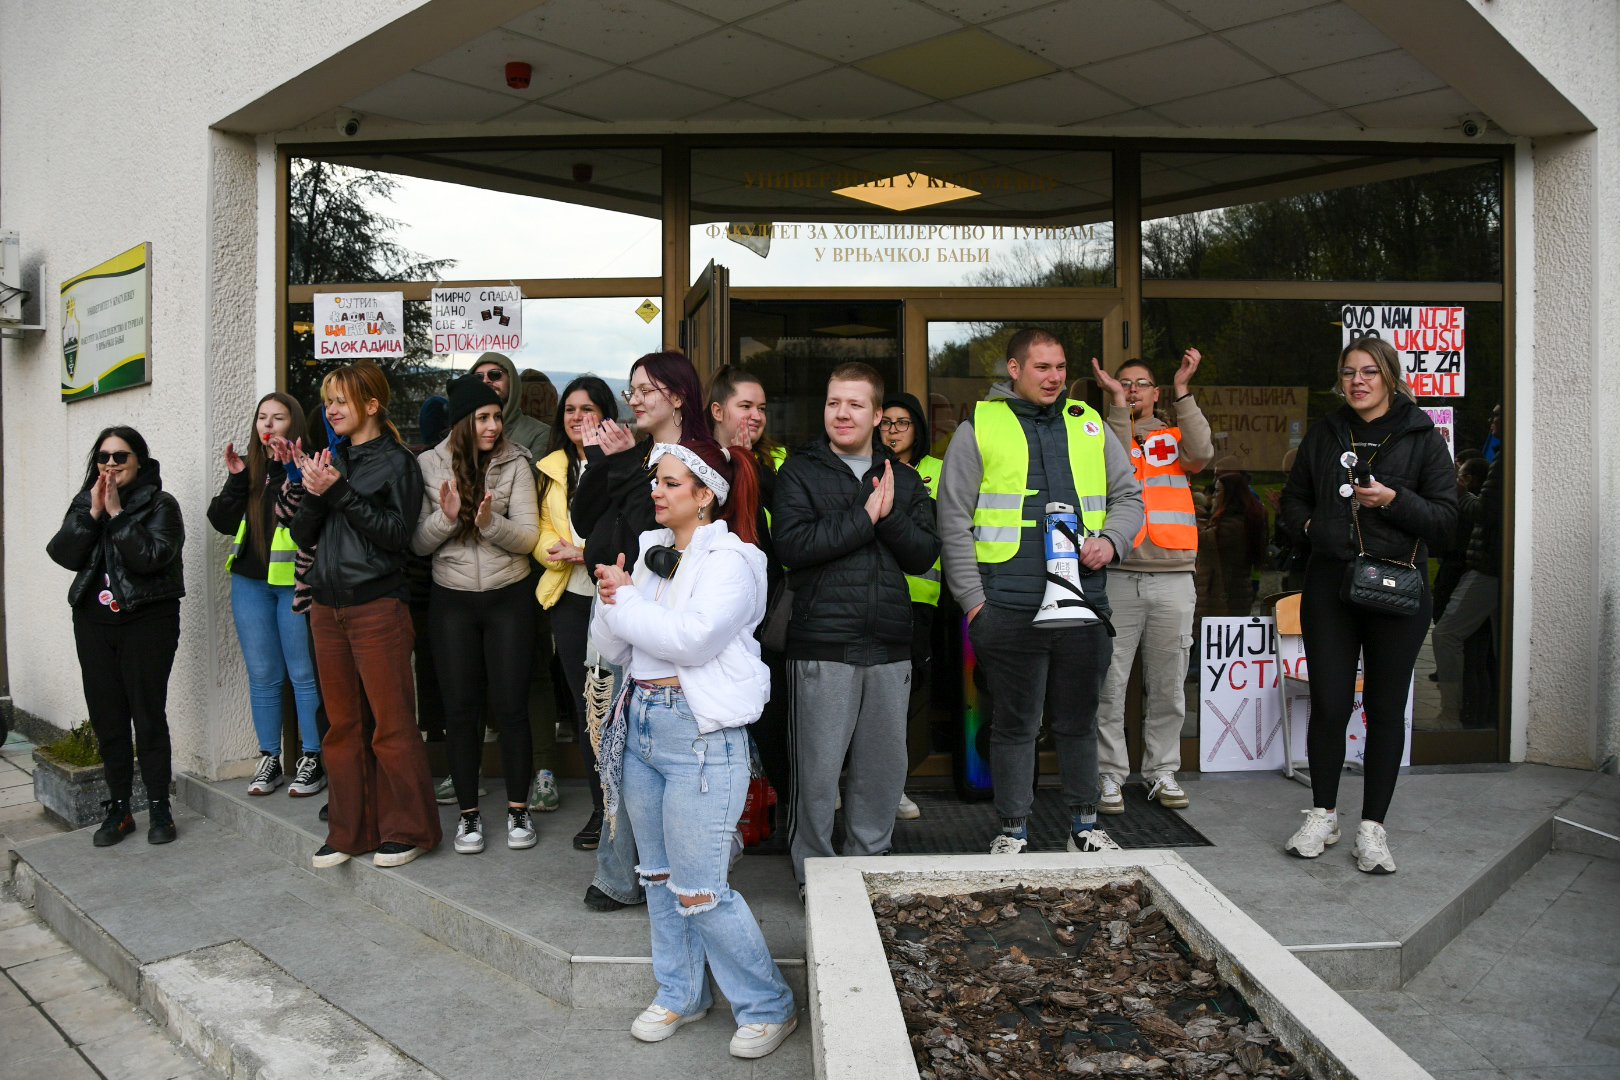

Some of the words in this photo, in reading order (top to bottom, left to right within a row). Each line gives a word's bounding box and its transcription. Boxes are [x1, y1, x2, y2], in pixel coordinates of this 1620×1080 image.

[743, 171, 896, 188] УНИВЕРЗИТЕТ
[906, 171, 919, 188] У
[927, 172, 1057, 190] КРАГУЈЕВЦУ
[705, 224, 802, 240] ФАКУЛТЕТ
[807, 224, 828, 240] ЗА
[833, 224, 986, 241] ХОТЕЛИЈЕРСТВО
[990, 225, 1005, 240] И
[1010, 225, 1095, 241] ТУРИЗАМ
[814, 247, 827, 263] У
[832, 247, 930, 263] ВРЊАЧКОЈ
[937, 247, 991, 263] БАЊИ
[435, 291, 471, 303] МИРНО
[480, 290, 519, 302] СПАВАЈ
[435, 305, 466, 317] НАНО
[1342, 306, 1375, 329] OVO
[1381, 307, 1412, 329] NAM
[1419, 307, 1463, 330] NIJE
[435, 319, 456, 331] СВЕ
[462, 319, 473, 330] ЈЕ
[321, 339, 402, 354] БЛОКАДИЦА
[435, 334, 520, 353] БЛОКИРАНО
[1393, 329, 1465, 351] UKUSU
[1406, 351, 1428, 373] JE
[1434, 351, 1461, 373] ZA
[1225, 387, 1296, 406] ТИШИНА
[1209, 413, 1288, 433] РЕПАСТИ
